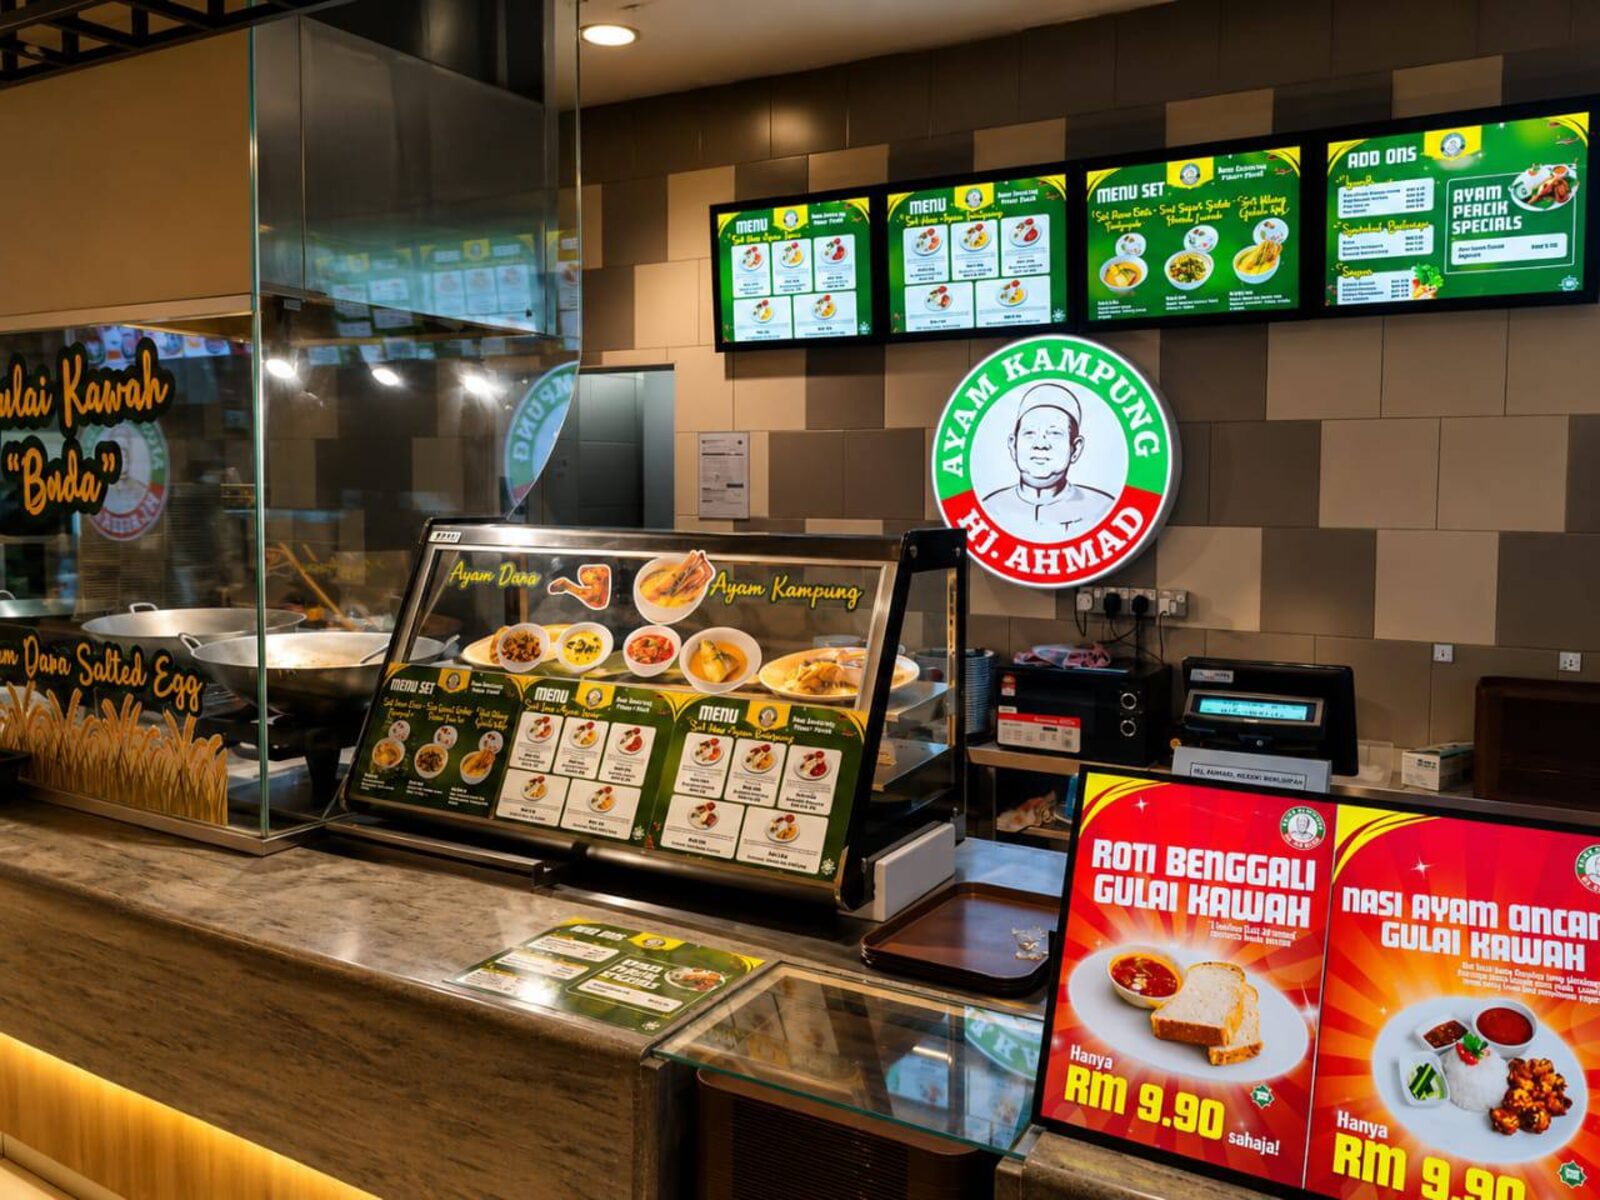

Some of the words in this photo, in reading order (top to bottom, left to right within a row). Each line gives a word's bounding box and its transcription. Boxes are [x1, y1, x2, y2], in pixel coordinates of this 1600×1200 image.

[1347, 149, 1380, 169] ADD
[1385, 145, 1417, 165] ONS
[909, 197, 947, 216] MENU
[1096, 183, 1138, 205] MENU
[1141, 181, 1166, 198] SET
[1453, 185, 1502, 204] AYAM
[735, 218, 768, 235] MENU
[1451, 215, 1523, 235] SPECIALS
[62, 349, 169, 428] Kawah
[942, 372, 1000, 478] AYAM
[1000, 347, 1161, 458] KAMPUNG
[956, 507, 999, 560] HJ.
[1003, 506, 1145, 575] AHMAD
[449, 559, 496, 590] Ayam
[709, 571, 766, 605] Ayam
[770, 574, 863, 610] Kampung
[76, 641, 148, 687] Salted
[152, 654, 204, 712] Egg
[390, 677, 420, 693] MENU
[418, 680, 436, 695] SET
[534, 686, 569, 704] MENU
[698, 704, 739, 724] MENU
[1091, 838, 1157, 875] ROTI
[1165, 845, 1316, 892] BENGGALI
[1093, 874, 1179, 913] GULAI
[1187, 883, 1311, 928] KAWAH
[1341, 886, 1403, 918] NASI
[1411, 893, 1499, 929] AYAM
[1381, 920, 1461, 956] GULAI
[1470, 931, 1586, 972] KAWAH
[1069, 1044, 1113, 1071] Hanya
[1063, 1063, 1128, 1117] RM
[1136, 1082, 1226, 1141] 9.90
[1228, 1131, 1281, 1157] sahaja!
[1337, 1110, 1389, 1139] Hanya
[1332, 1131, 1407, 1192] RM
